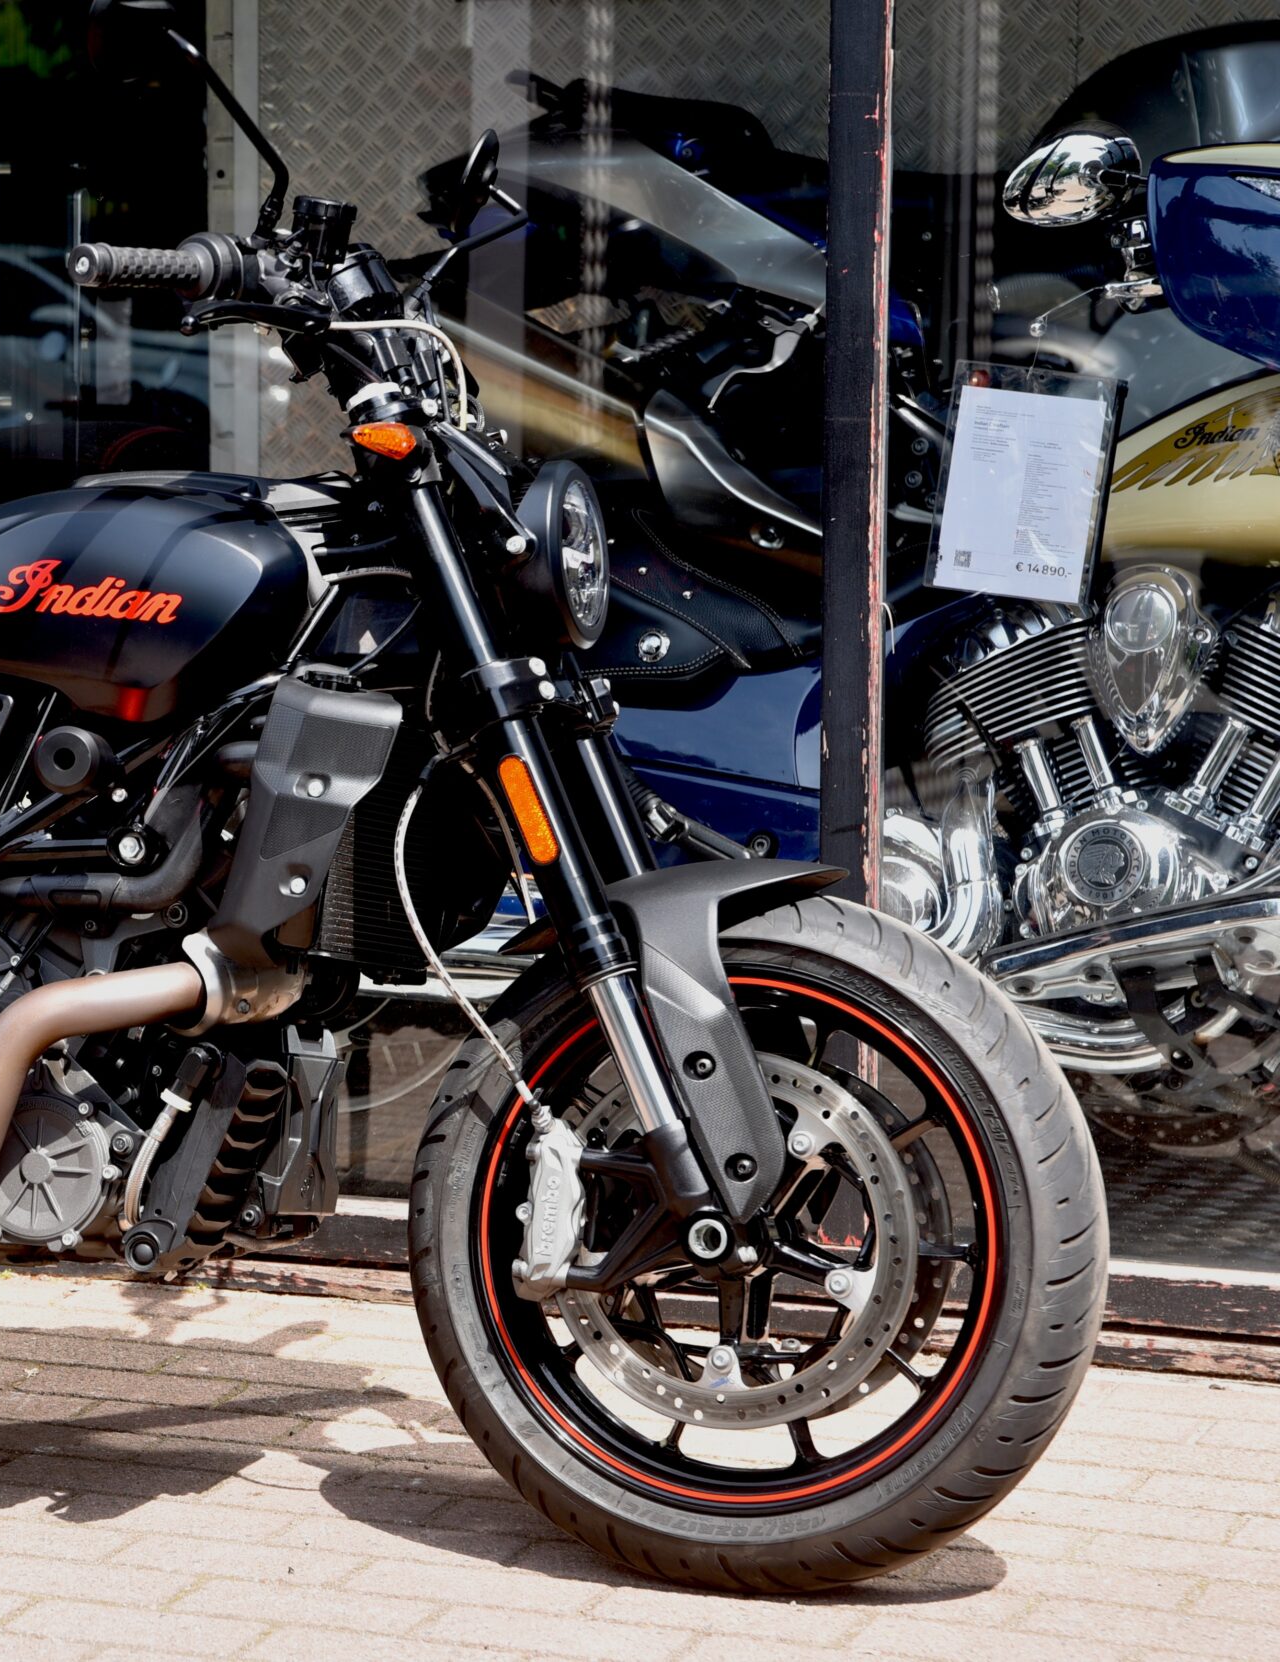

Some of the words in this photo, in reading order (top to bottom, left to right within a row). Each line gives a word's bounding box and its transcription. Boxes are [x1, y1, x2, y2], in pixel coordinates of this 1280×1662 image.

[1174, 421, 1261, 449] Indian
[1070, 836, 1087, 883] INDIAN
[1091, 827, 1141, 888] MOTORCYCLE
[535, 1175, 561, 1257] brembo
